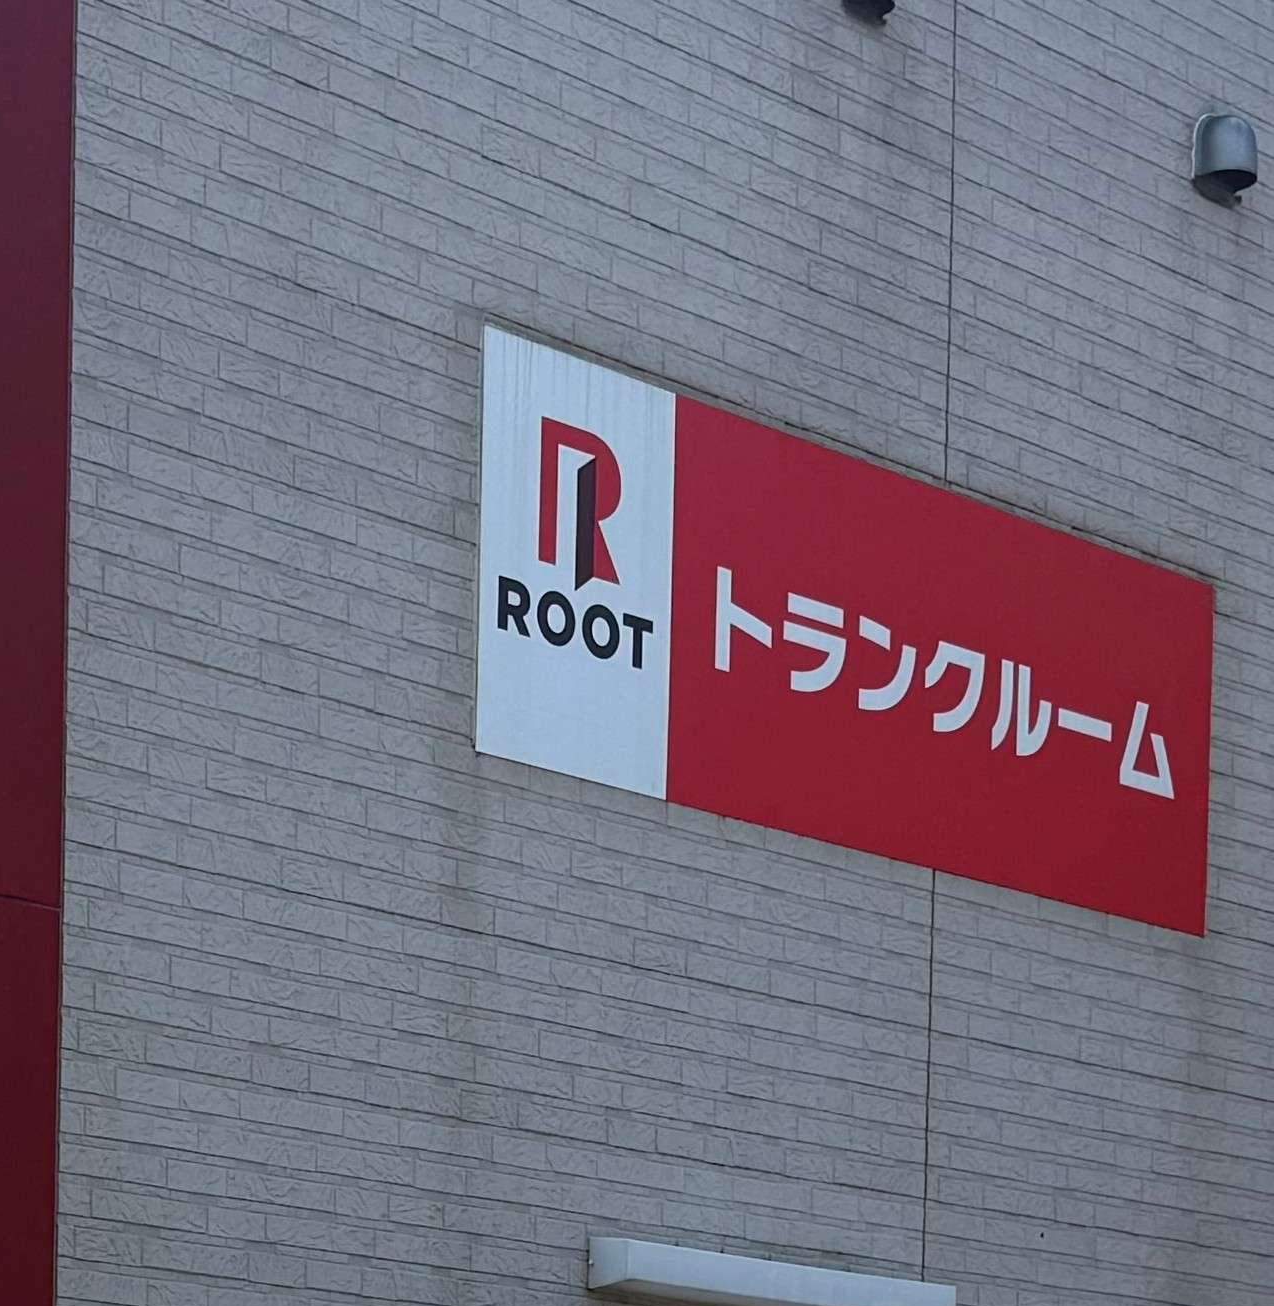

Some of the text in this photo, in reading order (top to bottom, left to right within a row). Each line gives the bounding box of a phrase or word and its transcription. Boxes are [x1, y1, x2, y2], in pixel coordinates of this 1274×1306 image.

[497, 575, 653, 669] ROOT
[715, 566, 1175, 799] トランクルーム
